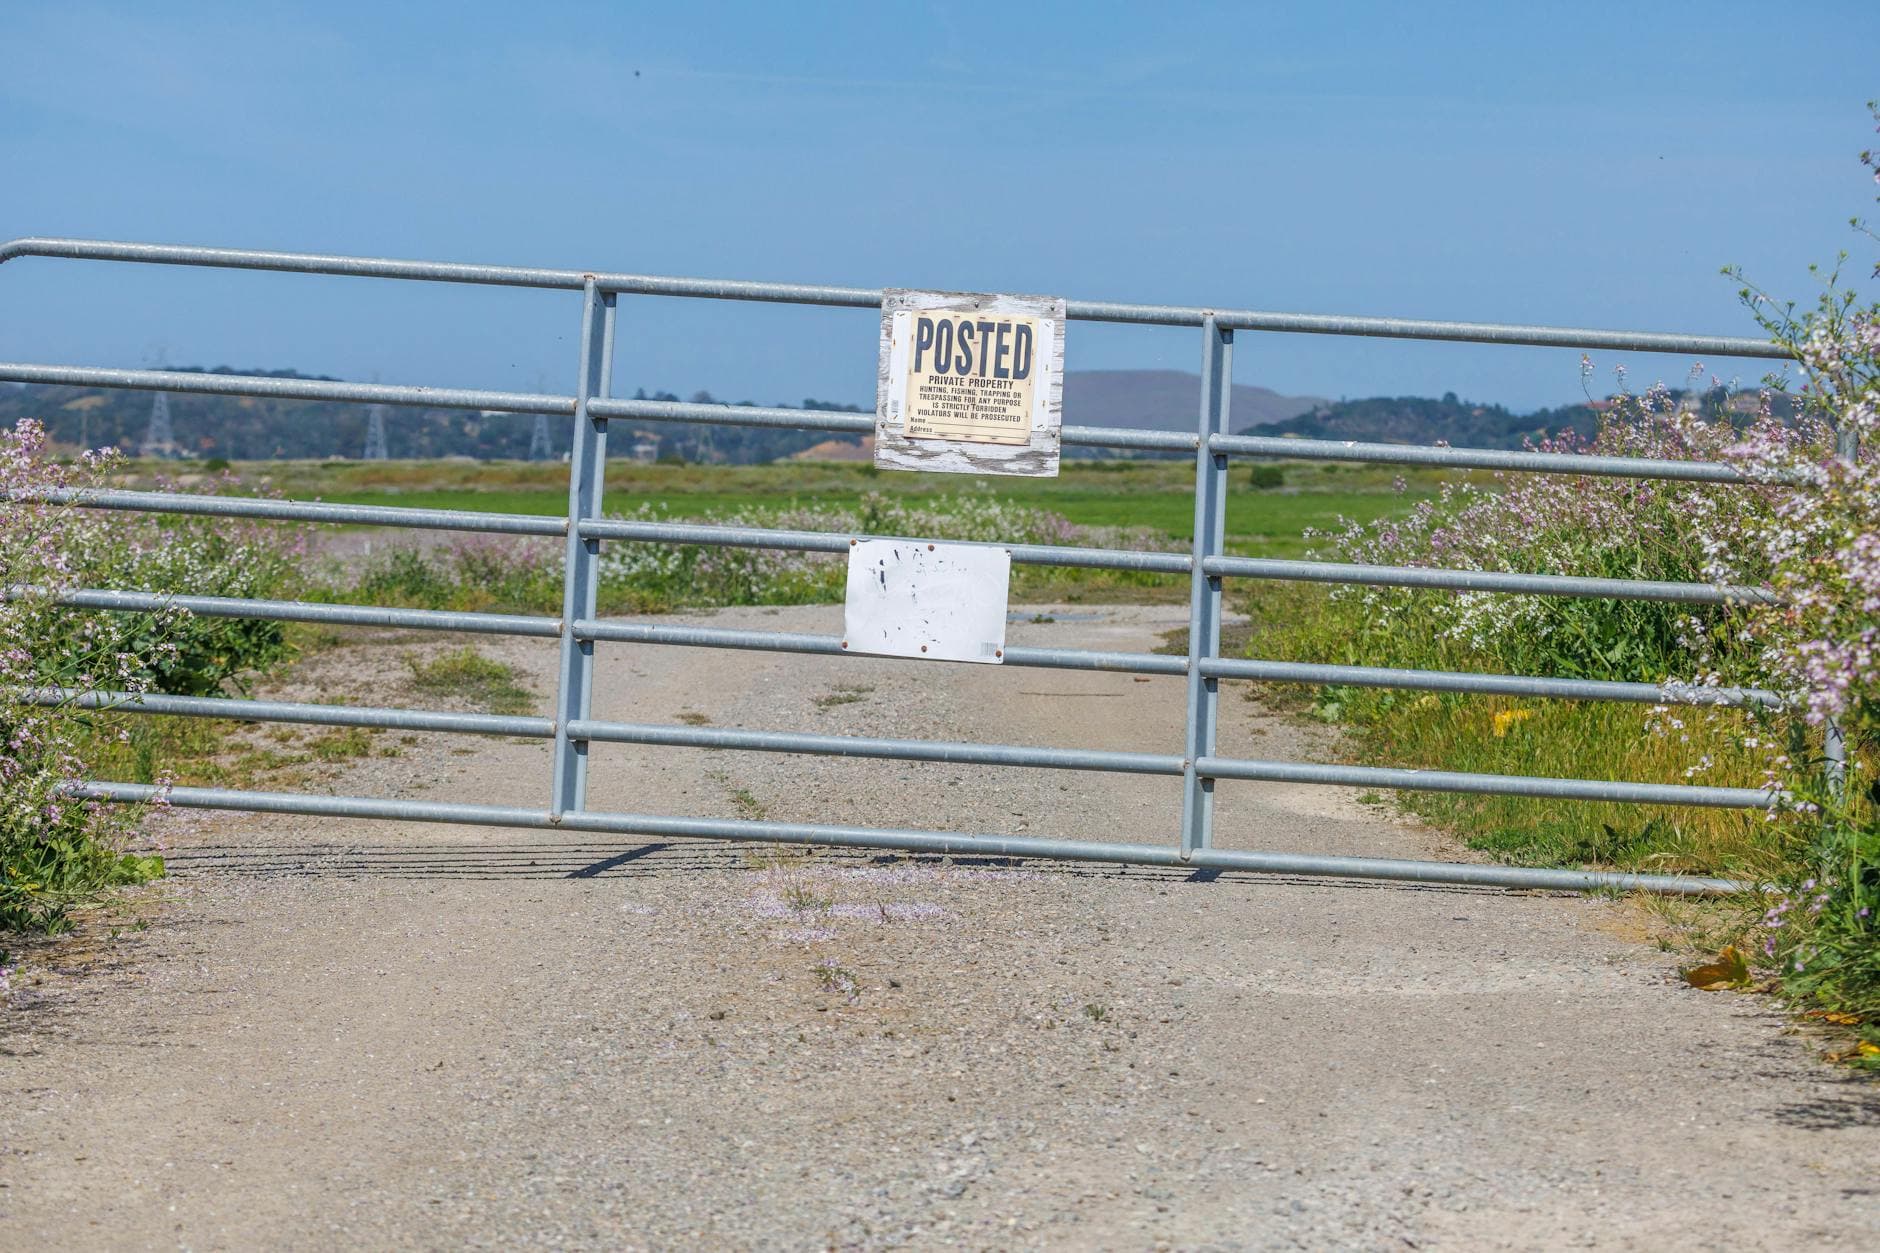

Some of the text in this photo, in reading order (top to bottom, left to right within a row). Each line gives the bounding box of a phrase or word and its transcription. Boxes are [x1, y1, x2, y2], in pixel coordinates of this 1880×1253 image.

[914, 317, 1033, 380] POSTED
[929, 376, 1014, 389] PRIVATE PROPERTY
[920, 386, 948, 394] HUNTING,
[951, 388, 977, 396] FISHING,
[920, 394, 961, 402] TRESPASSING
[942, 403, 970, 411] STRICTLY
[918, 409, 951, 417] VIOLATORS
[981, 414, 1020, 422] PROSECUTED
